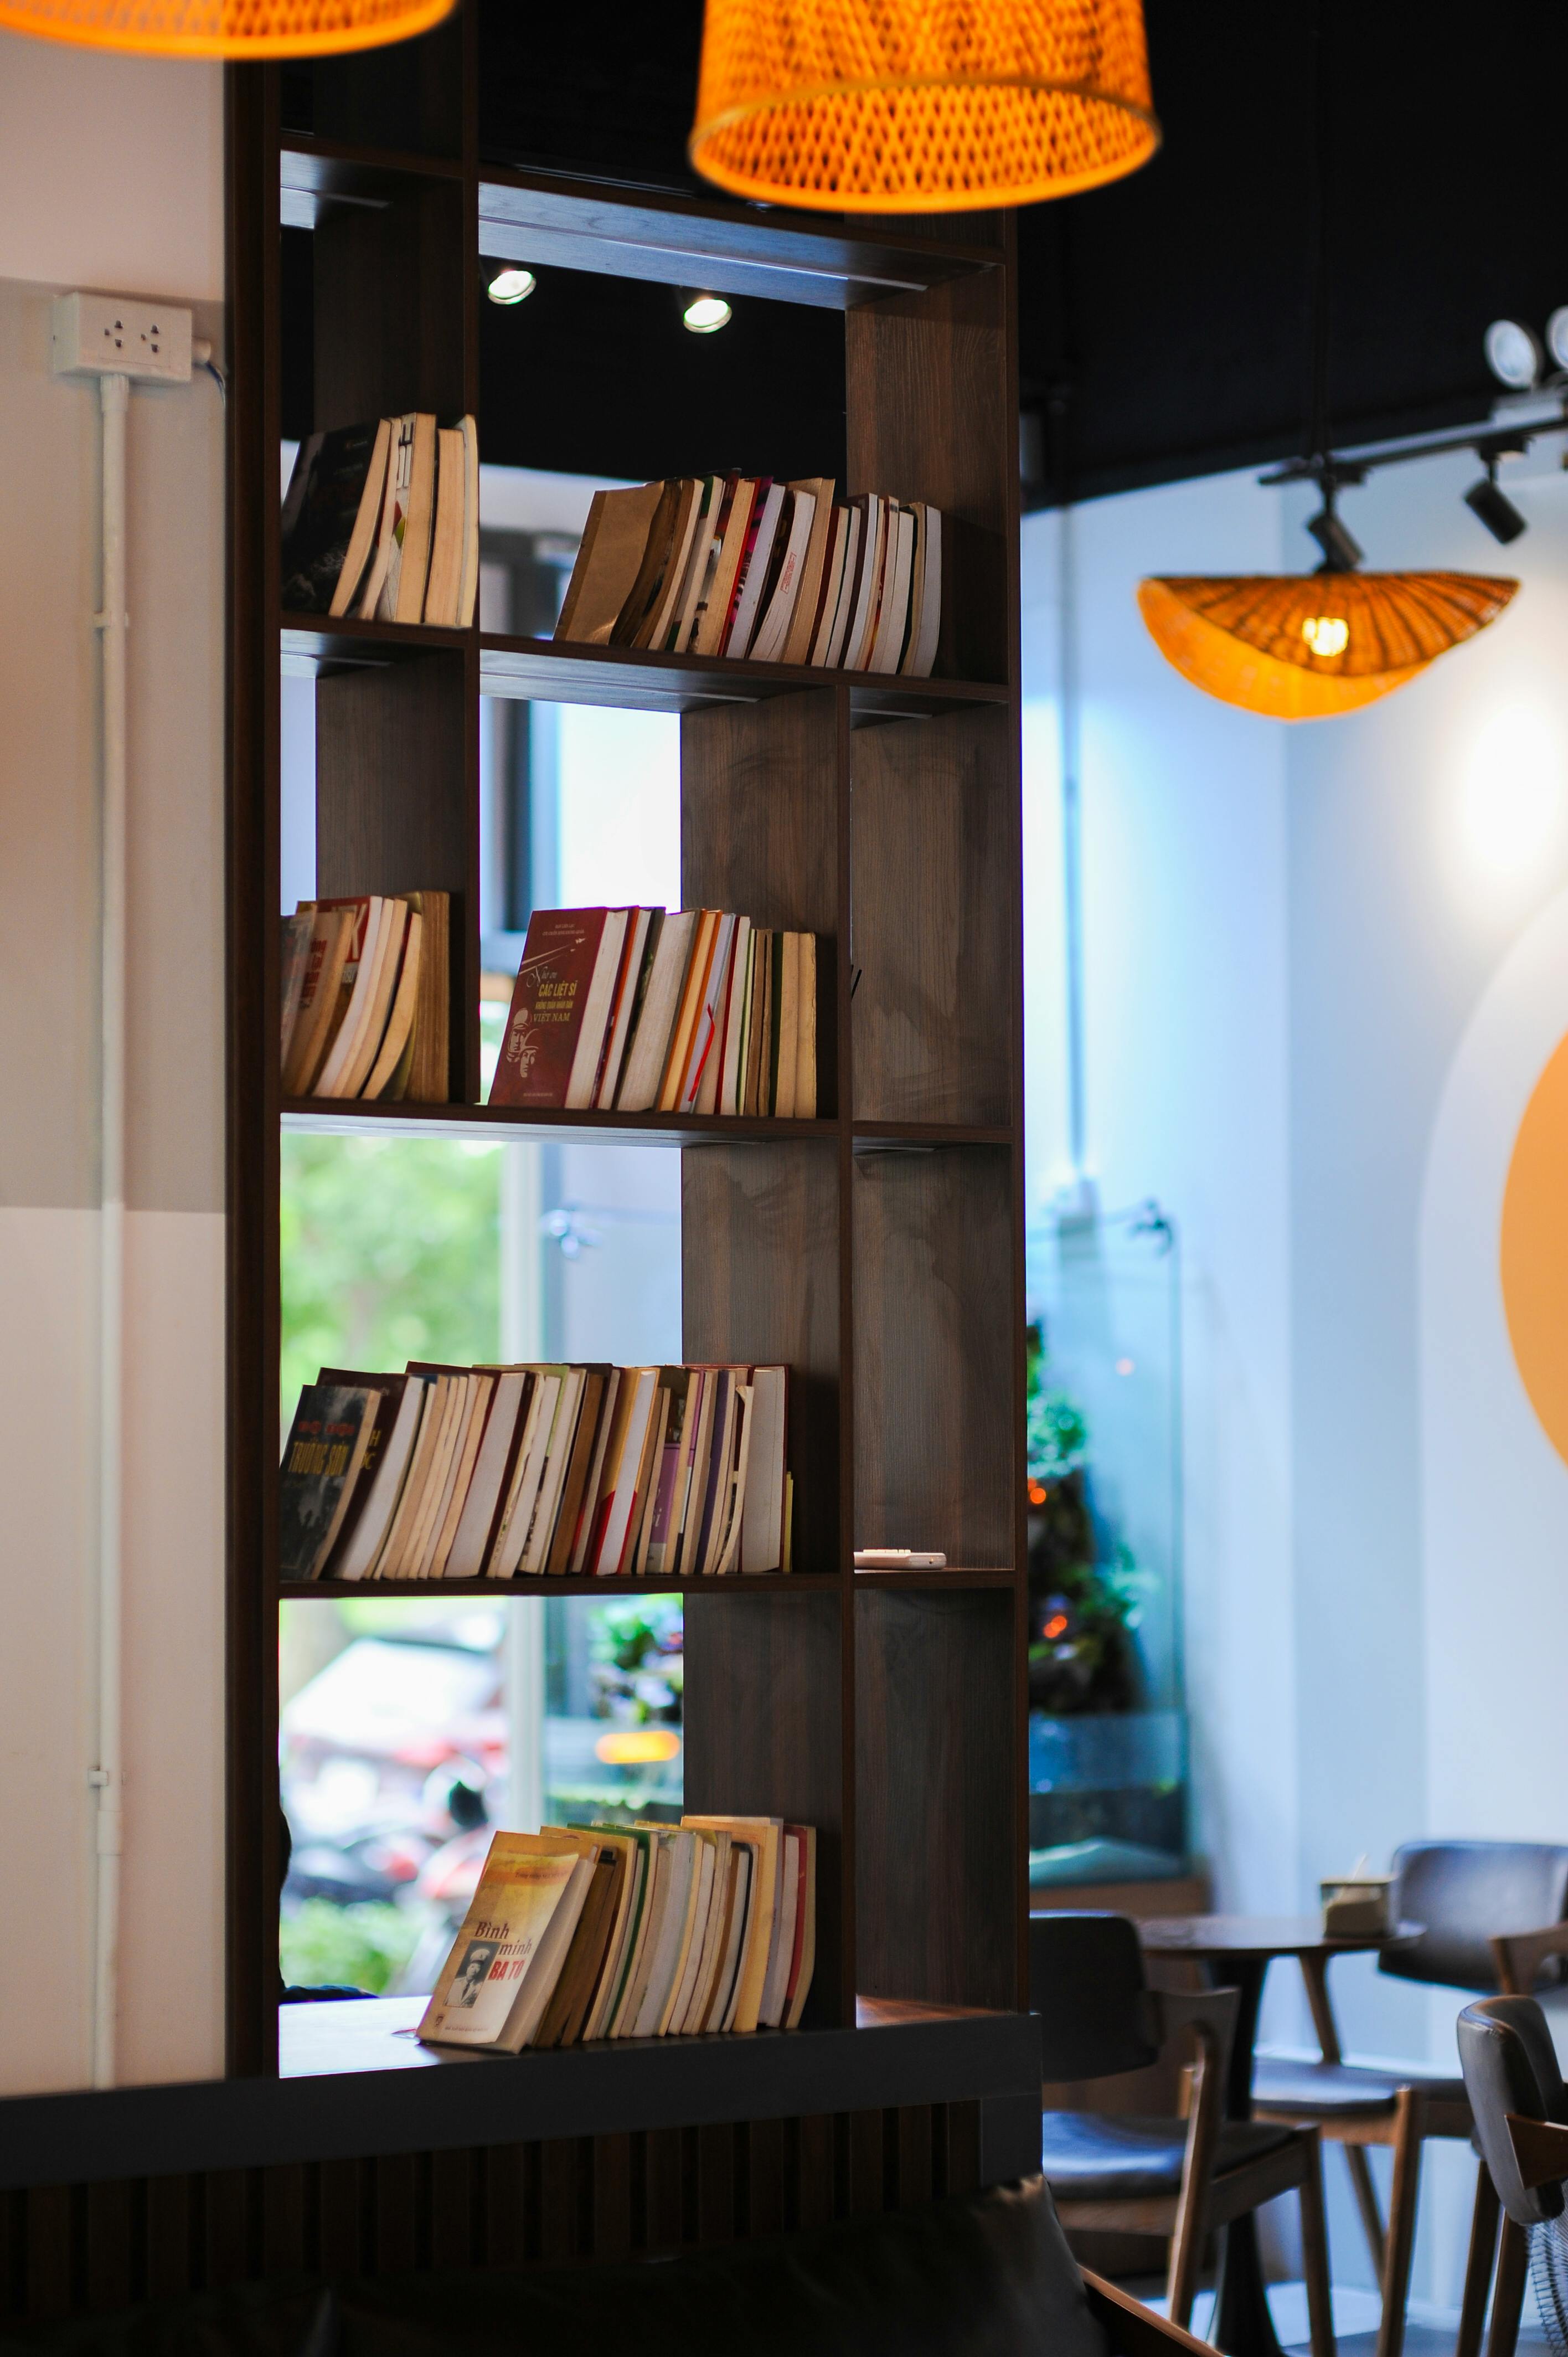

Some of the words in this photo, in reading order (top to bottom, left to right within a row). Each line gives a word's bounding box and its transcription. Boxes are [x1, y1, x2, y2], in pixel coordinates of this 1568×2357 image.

[539, 981, 553, 997] CÁC
[554, 980, 568, 999] LIỆT
[534, 1011, 551, 1023] VIỆT
[551, 1012, 571, 1022] NAM
[474, 1921, 510, 1939] Bình
[498, 1938, 532, 1956] minh
[488, 1960, 510, 1981] BA
